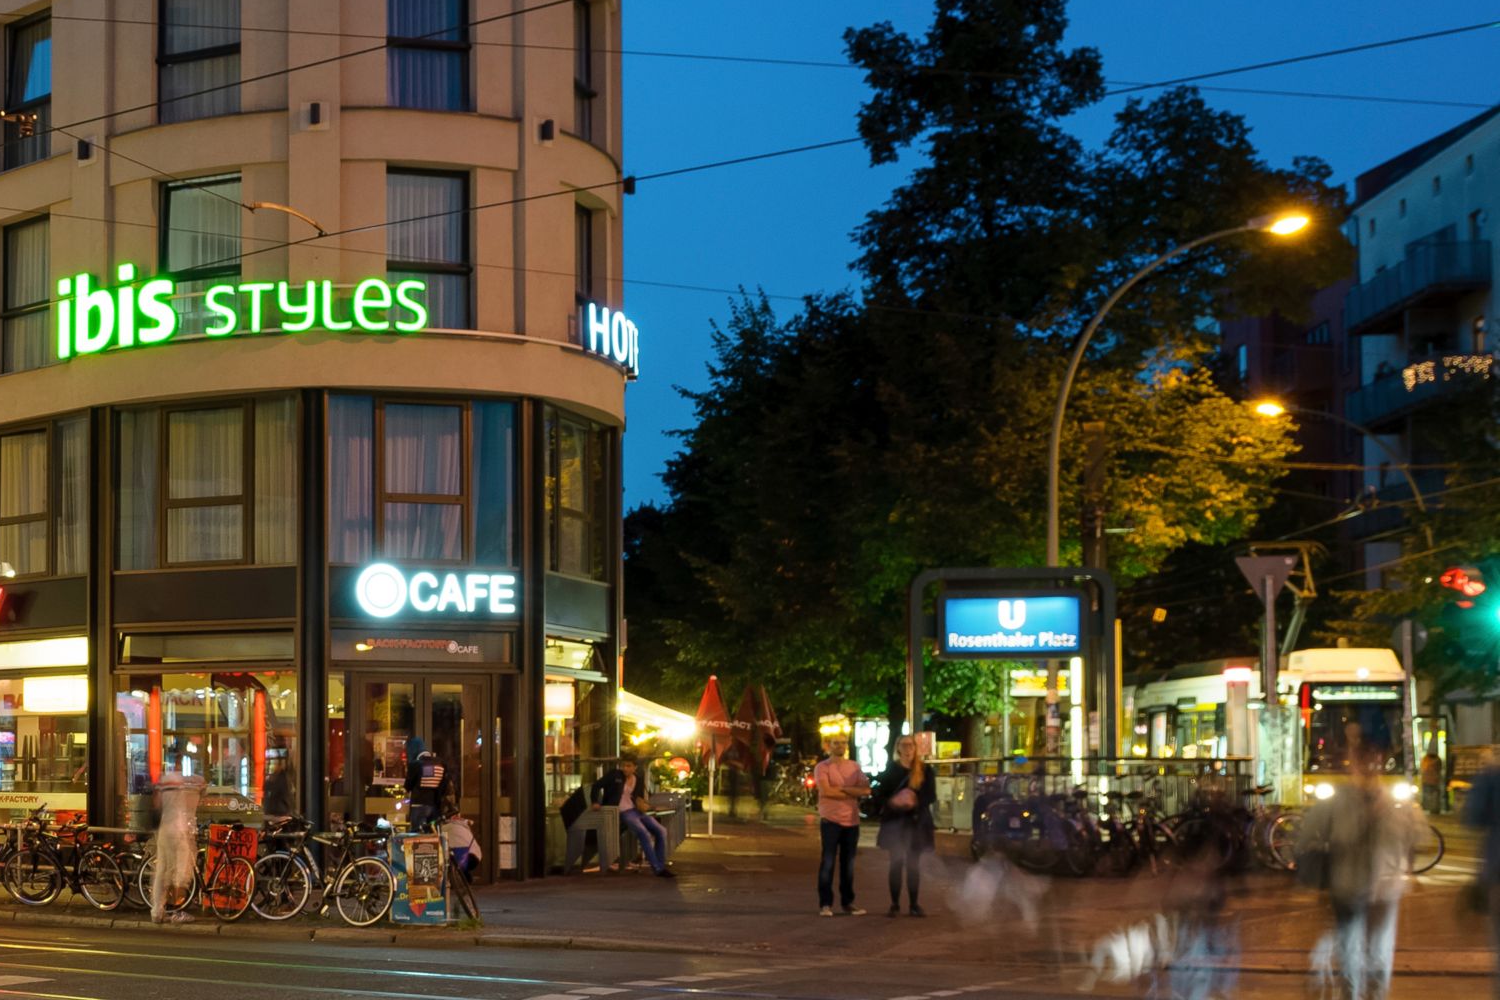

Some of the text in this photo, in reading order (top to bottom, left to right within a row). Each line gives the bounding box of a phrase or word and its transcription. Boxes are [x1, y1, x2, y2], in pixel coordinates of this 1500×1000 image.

[57, 262, 176, 359] ibis
[408, 572, 516, 614] CAFE
[948, 631, 1077, 647] Rosenthaler Platz
